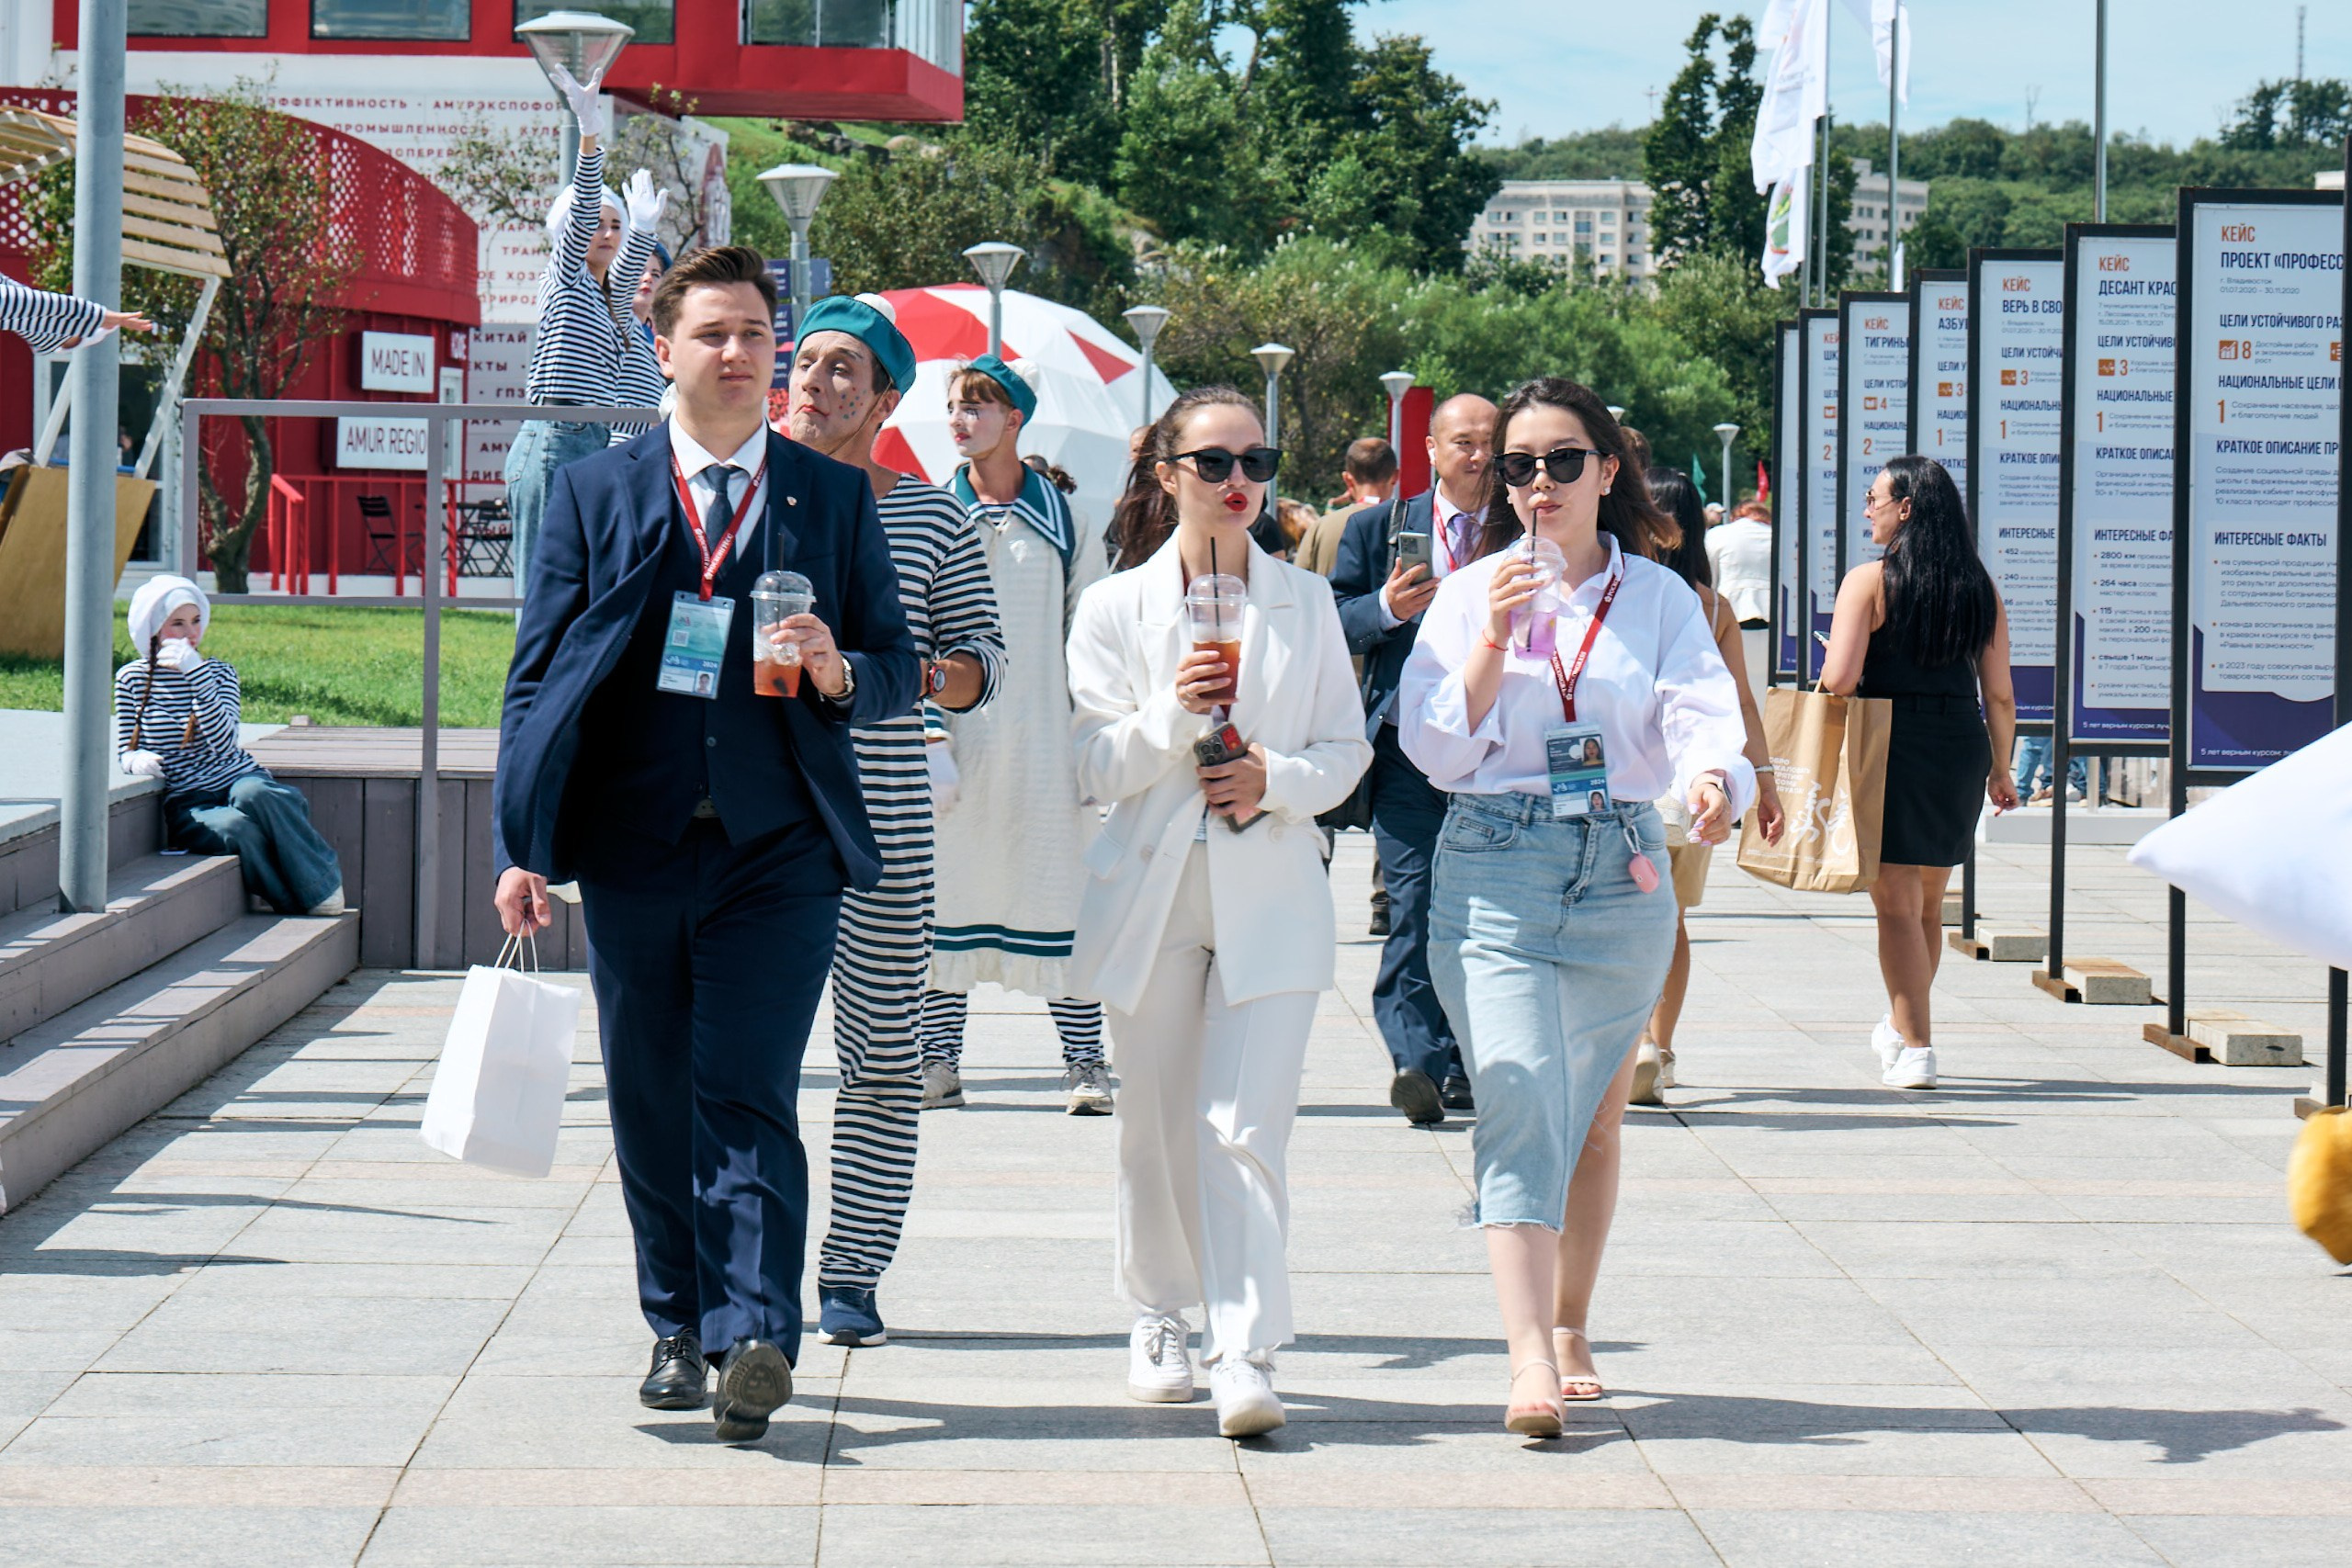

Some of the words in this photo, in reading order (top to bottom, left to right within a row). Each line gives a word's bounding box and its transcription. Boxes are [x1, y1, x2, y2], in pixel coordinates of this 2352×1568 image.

[2221, 223, 2256, 242] КЕЙС
[2099, 254, 2130, 271] КЕЙС
[2221, 252, 2271, 268] ПРОЕКТ
[2003, 276, 2030, 291] КЕЙС
[2098, 280, 2144, 296] ДЕСАНТ
[1939, 296, 1964, 310] КЕЙС
[2003, 299, 2029, 312] ВЕРЬ
[2032, 300, 2039, 313] В
[2041, 300, 2062, 313] СВО
[1865, 317, 1889, 330] КЕЙС
[2220, 314, 2248, 328] ЦЕЛИ
[2251, 312, 2324, 329] УСТОЙЧИВОГО
[473, 332, 526, 343] КИТАЙ
[2098, 336, 2122, 348] ЦЕЛИ
[2002, 347, 2024, 358] ЦЕЛИ
[2242, 341, 2252, 359] 8
[372, 349, 408, 377] MADE
[413, 353, 425, 377] IN
[1938, 362, 1959, 371] ЦЕЛИ
[2120, 359, 2128, 376] 3
[1864, 379, 1883, 389] ЦЕЛИ
[2020, 370, 2028, 385] 3
[2219, 375, 2304, 389] НАЦИОНАЛЬНЫЕ
[2307, 377, 2335, 390] ЦЕЛИ
[497, 389, 526, 399] ГПЗ
[1957, 383, 1963, 396] 3
[2098, 389, 2173, 402] НАЦИОНАЛЬНЫЕ
[1881, 397, 1887, 410] 4
[2217, 399, 2225, 423] 1
[2232, 401, 2279, 411] Сохранение
[2238, 412, 2291, 421] благополучие
[2293, 412, 2319, 421] людей
[2000, 420, 2007, 439] 1
[2097, 412, 2103, 433] 1
[345, 426, 384, 453] AMUR
[389, 428, 427, 455] REGIO
[1937, 429, 1942, 446] 1
[1823, 445, 1831, 459] 2
[1863, 438, 1872, 456] 2
[2096, 447, 2137, 459] КРАТКОЕ
[2217, 440, 2263, 454] КРАТКОЕ
[2266, 441, 2321, 455] ОПИСАНИЕ
[2324, 442, 2338, 455] ПР
[1999, 453, 2038, 464] КРАТКОЕ
[2216, 466, 2255, 475] Создание
[2256, 468, 2303, 476] социальной
[1999, 527, 2055, 539] ИНТЕРЕСНЫЕ
[2095, 529, 2156, 541] ИНТЕРЕСНЫЕ
[2214, 532, 2284, 546] ИНТЕРЕСНЫЕ
[2287, 533, 2326, 547] ФАКТЫ
[2246, 663, 2265, 671] году
